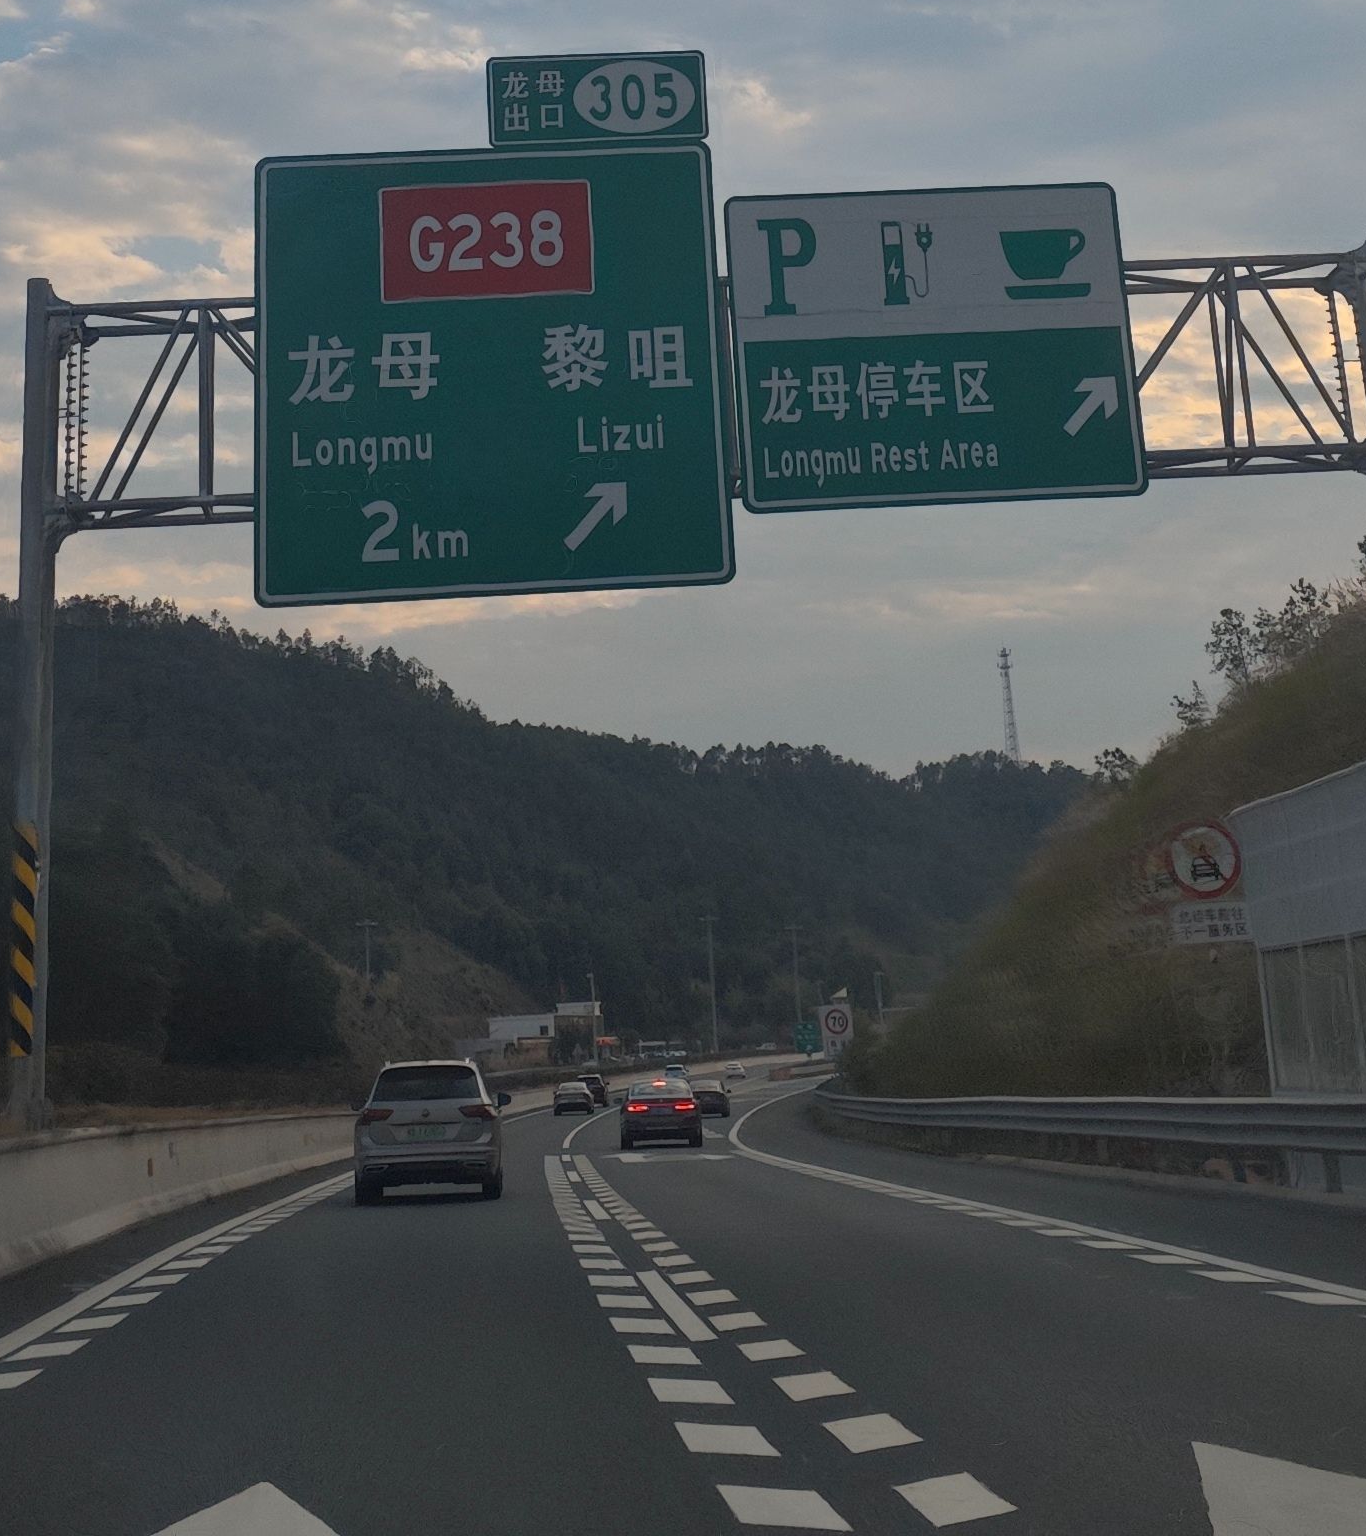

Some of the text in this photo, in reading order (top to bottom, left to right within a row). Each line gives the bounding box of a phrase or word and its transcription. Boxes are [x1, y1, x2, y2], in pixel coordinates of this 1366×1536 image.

[501, 70, 565, 99] 龙母
[589, 73, 678, 121] 305
[503, 103, 564, 132] 出口
[408, 210, 565, 272] G238
[756, 217, 817, 316] P
[288, 331, 441, 405] 龙母
[541, 323, 694, 392] 黎咀
[759, 360, 995, 425] 龙母停车区
[291, 430, 433, 475] Longmu
[577, 413, 664, 453] Lizui
[763, 438, 999, 489] Longmu Rest Area
[830, 1015, 845, 1028] 70
